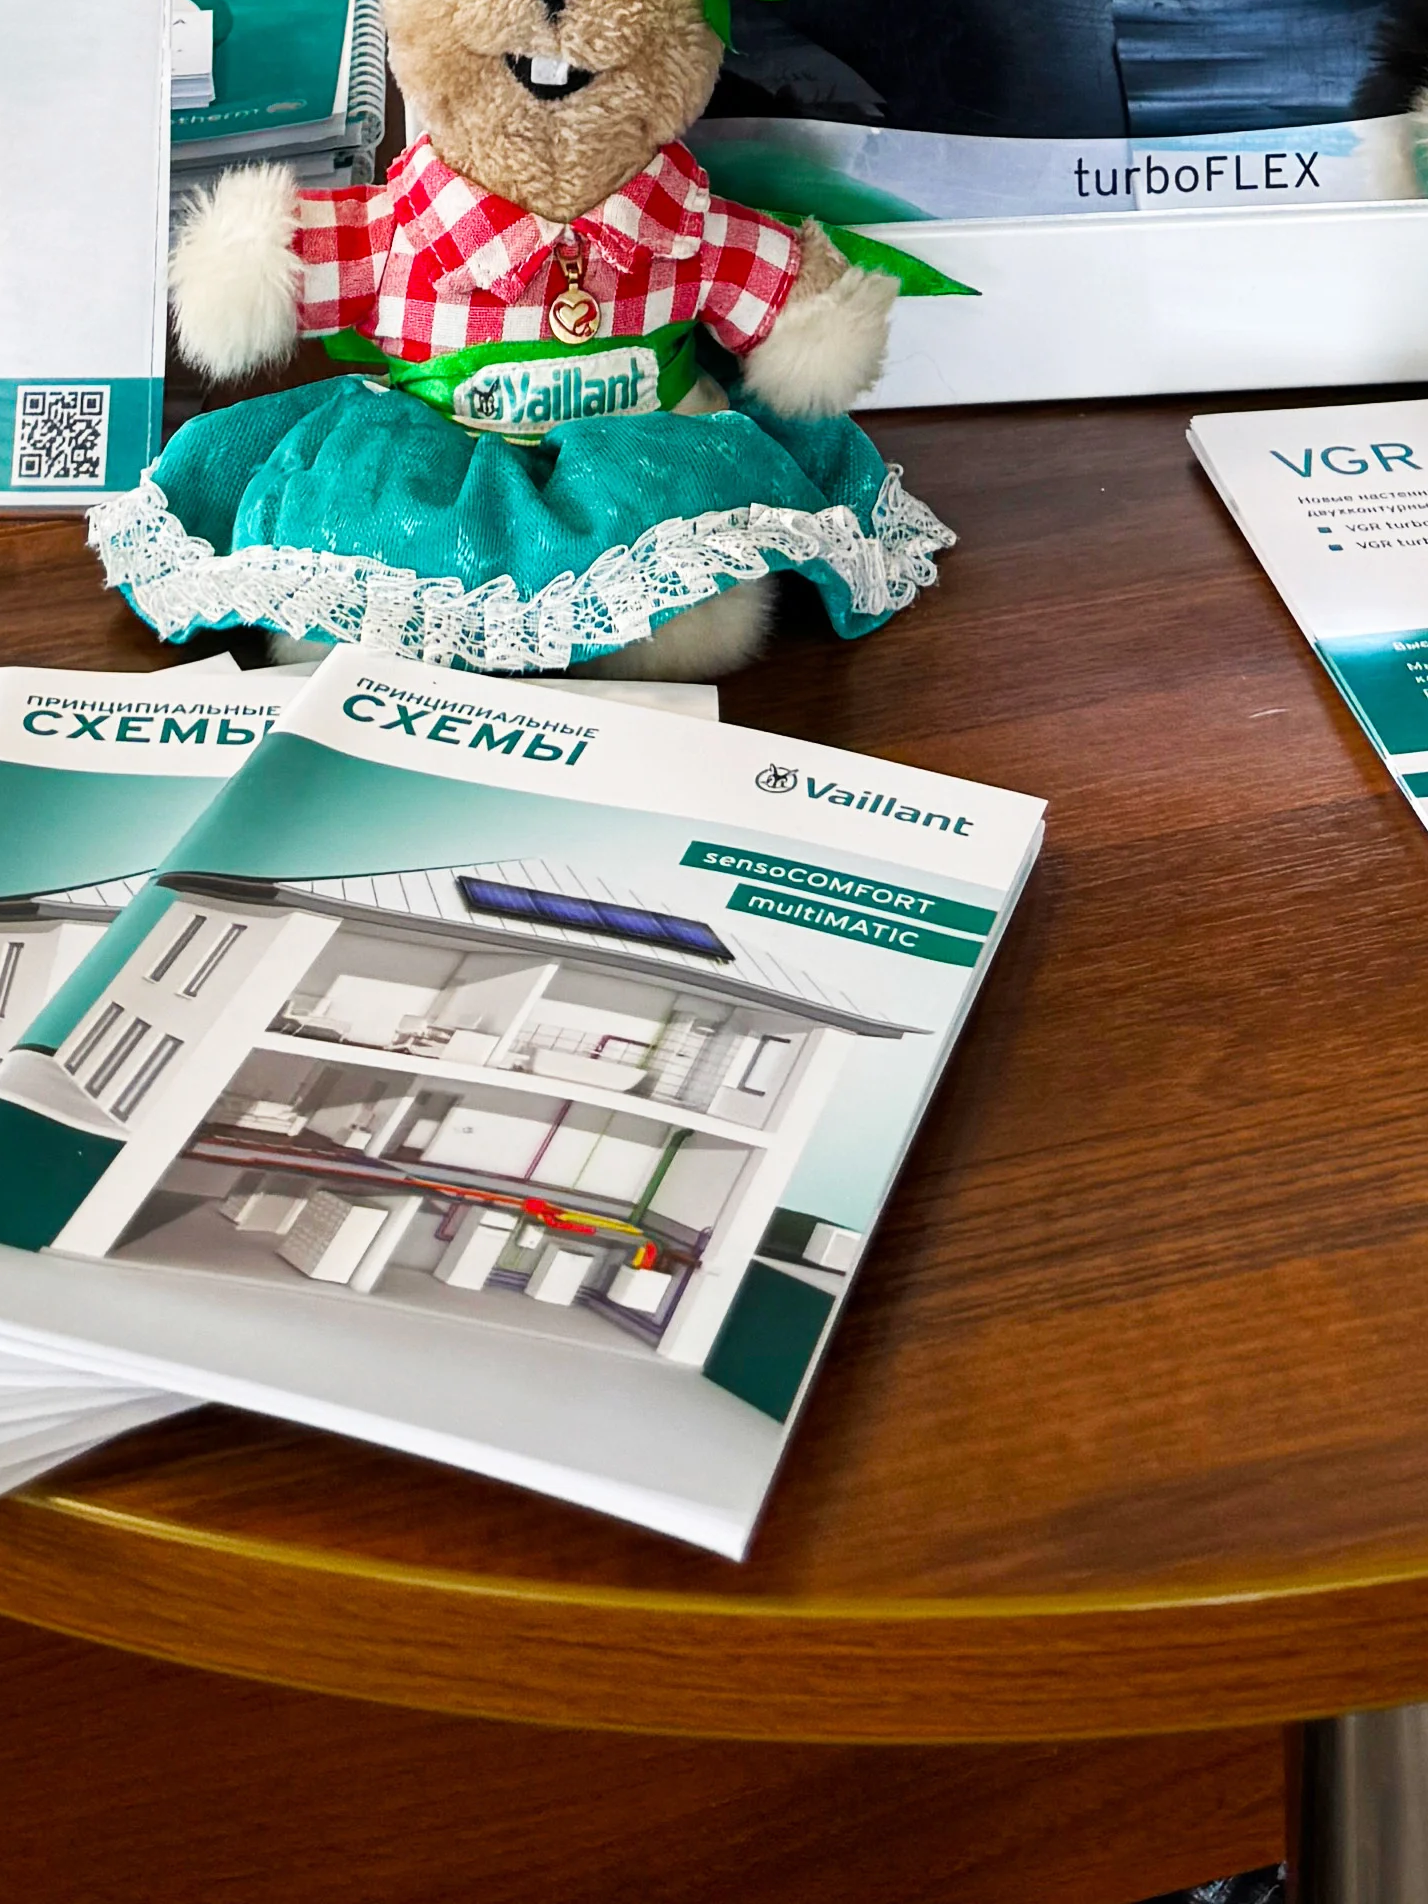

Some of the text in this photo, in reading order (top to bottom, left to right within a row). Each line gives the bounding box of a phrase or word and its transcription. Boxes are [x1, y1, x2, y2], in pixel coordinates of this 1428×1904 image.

[1074, 150, 1321, 198] turboFLEX
[502, 357, 646, 424] Vaillant
[1269, 442, 1424, 478] VGR
[26, 694, 282, 718] ПРИНЦИПИАЛЬНЫЕ
[341, 693, 590, 767] СХЕМЫ
[355, 675, 601, 740] ПРИНЦИПИАЛЬНЫЕ
[805, 776, 975, 837] Vaillant
[703, 849, 937, 915] sensoCOMFORT
[746, 893, 921, 949] multiMATIC
